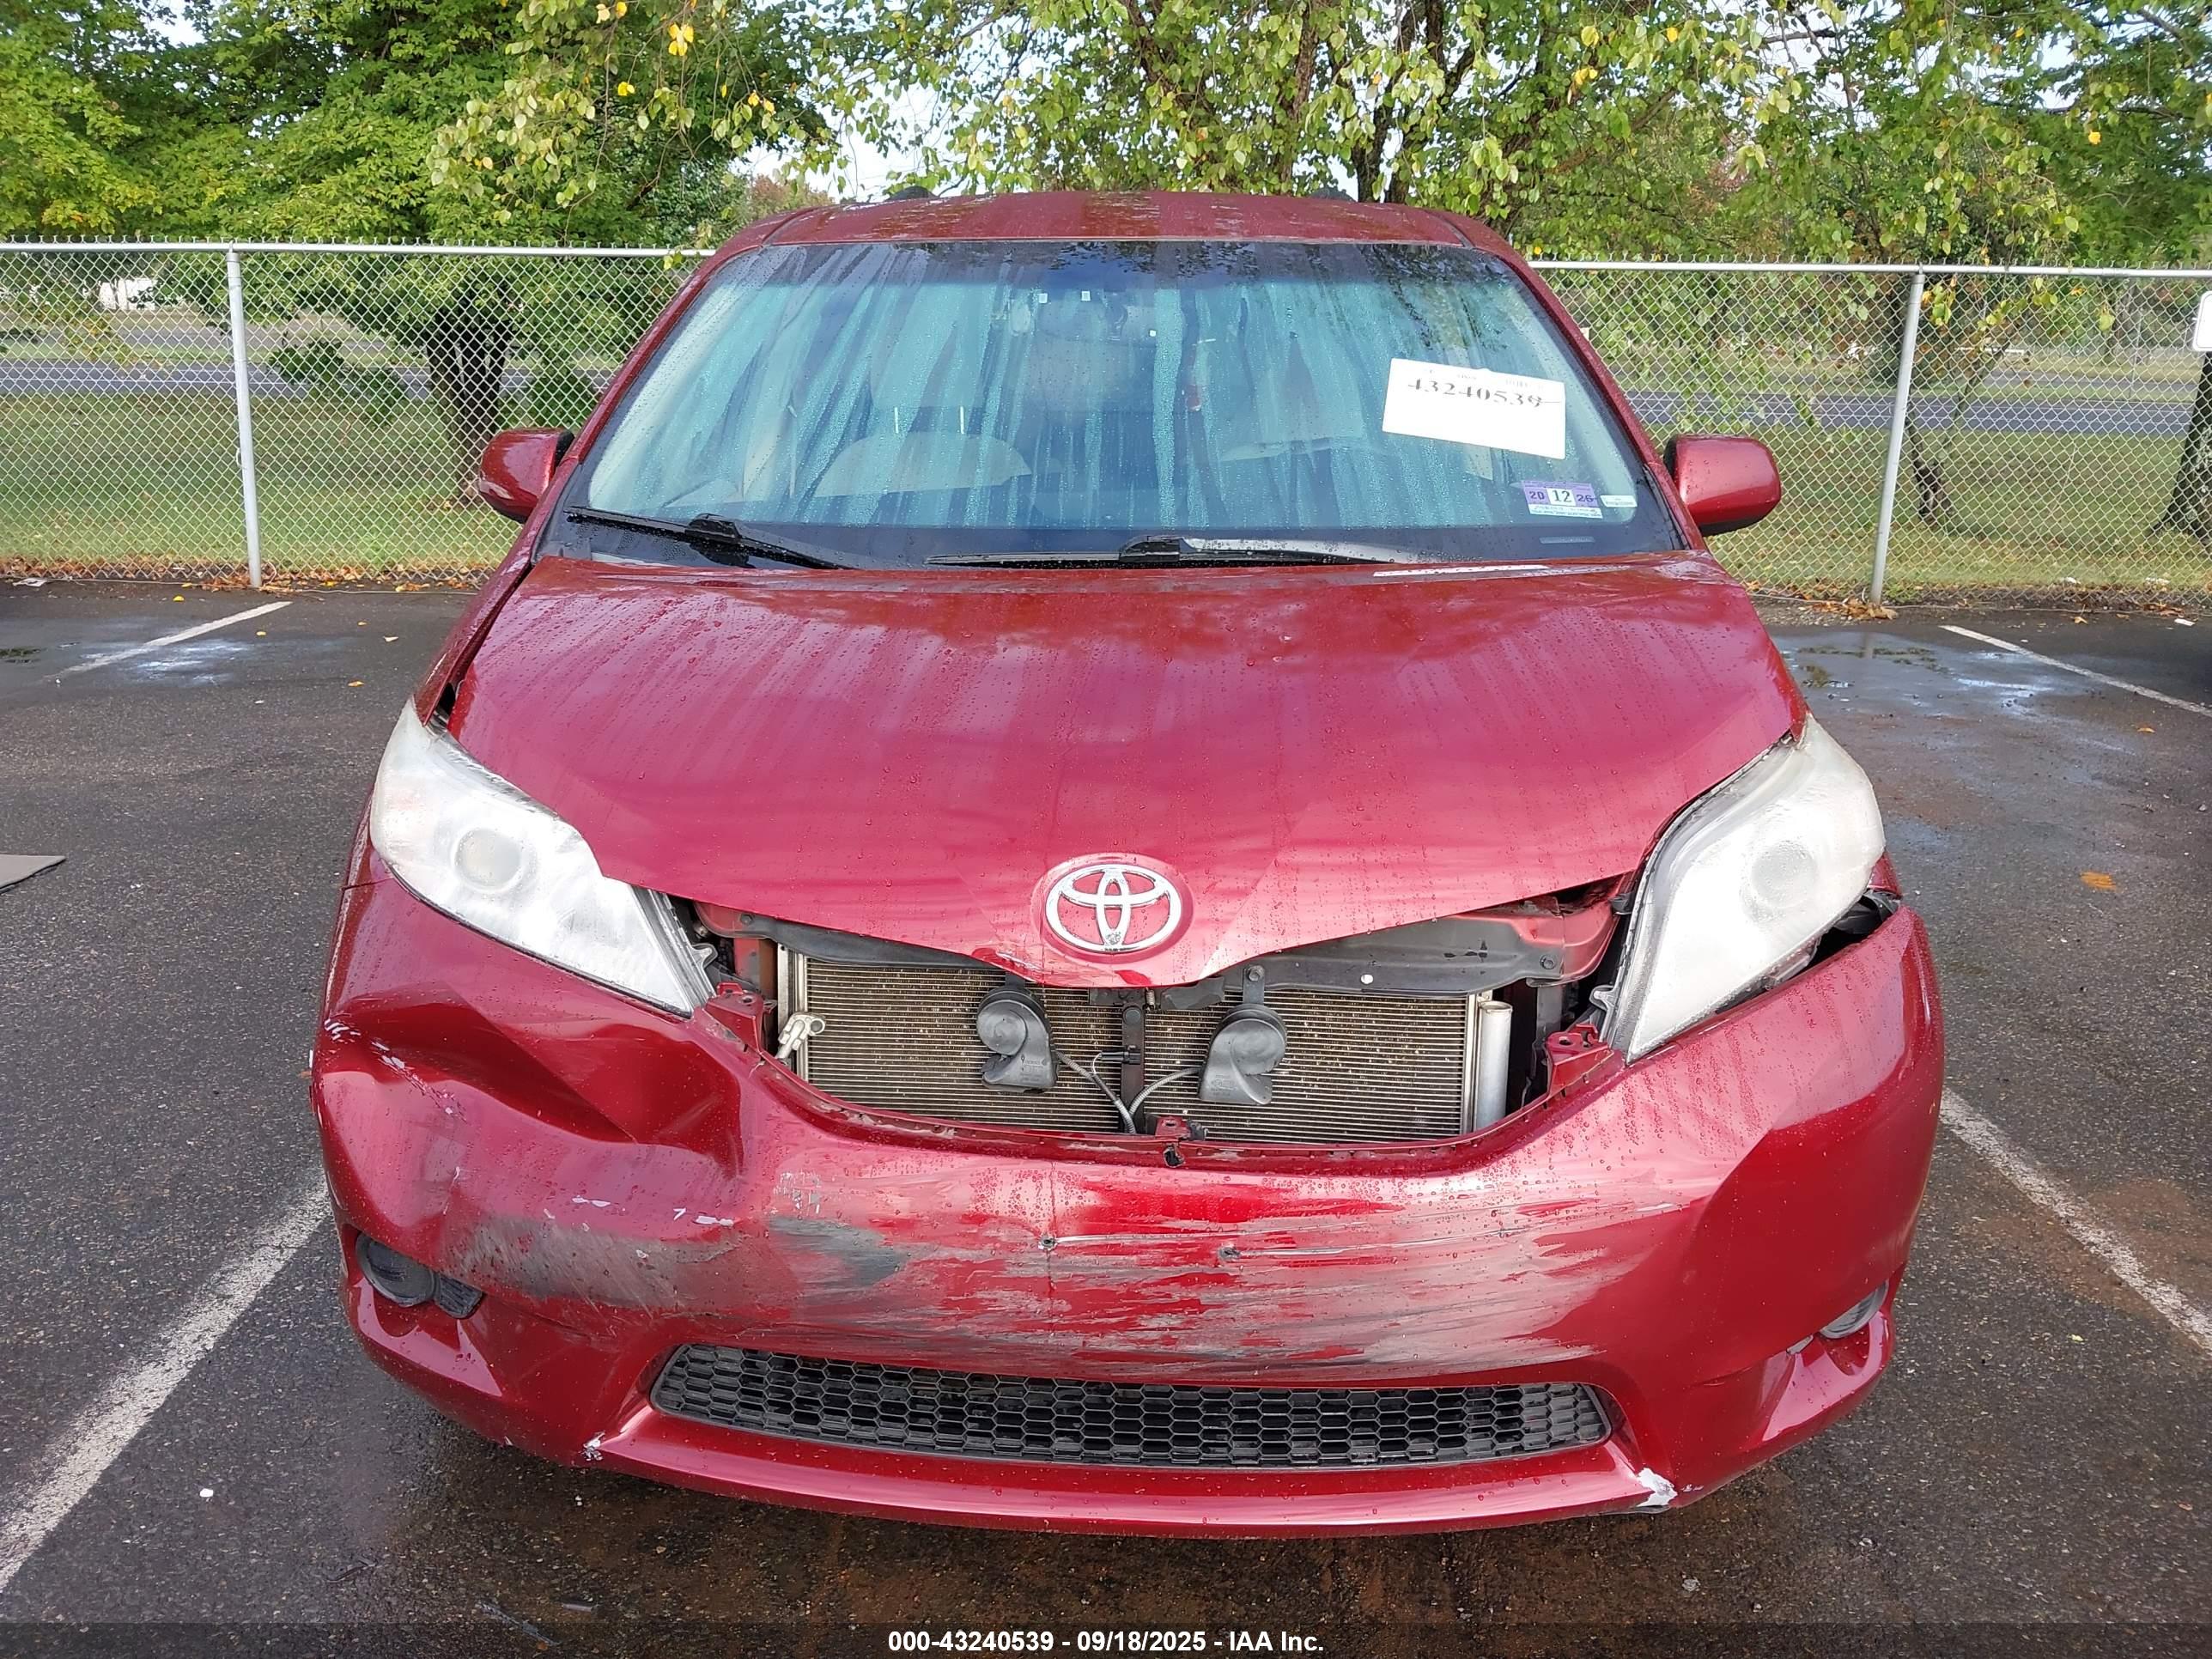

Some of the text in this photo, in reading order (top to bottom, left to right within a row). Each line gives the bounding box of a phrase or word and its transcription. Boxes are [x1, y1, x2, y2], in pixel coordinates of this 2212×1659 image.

[1528, 490, 1545, 500] 20
[1552, 489, 1572, 502] 12
[1576, 494, 1593, 502] 26
